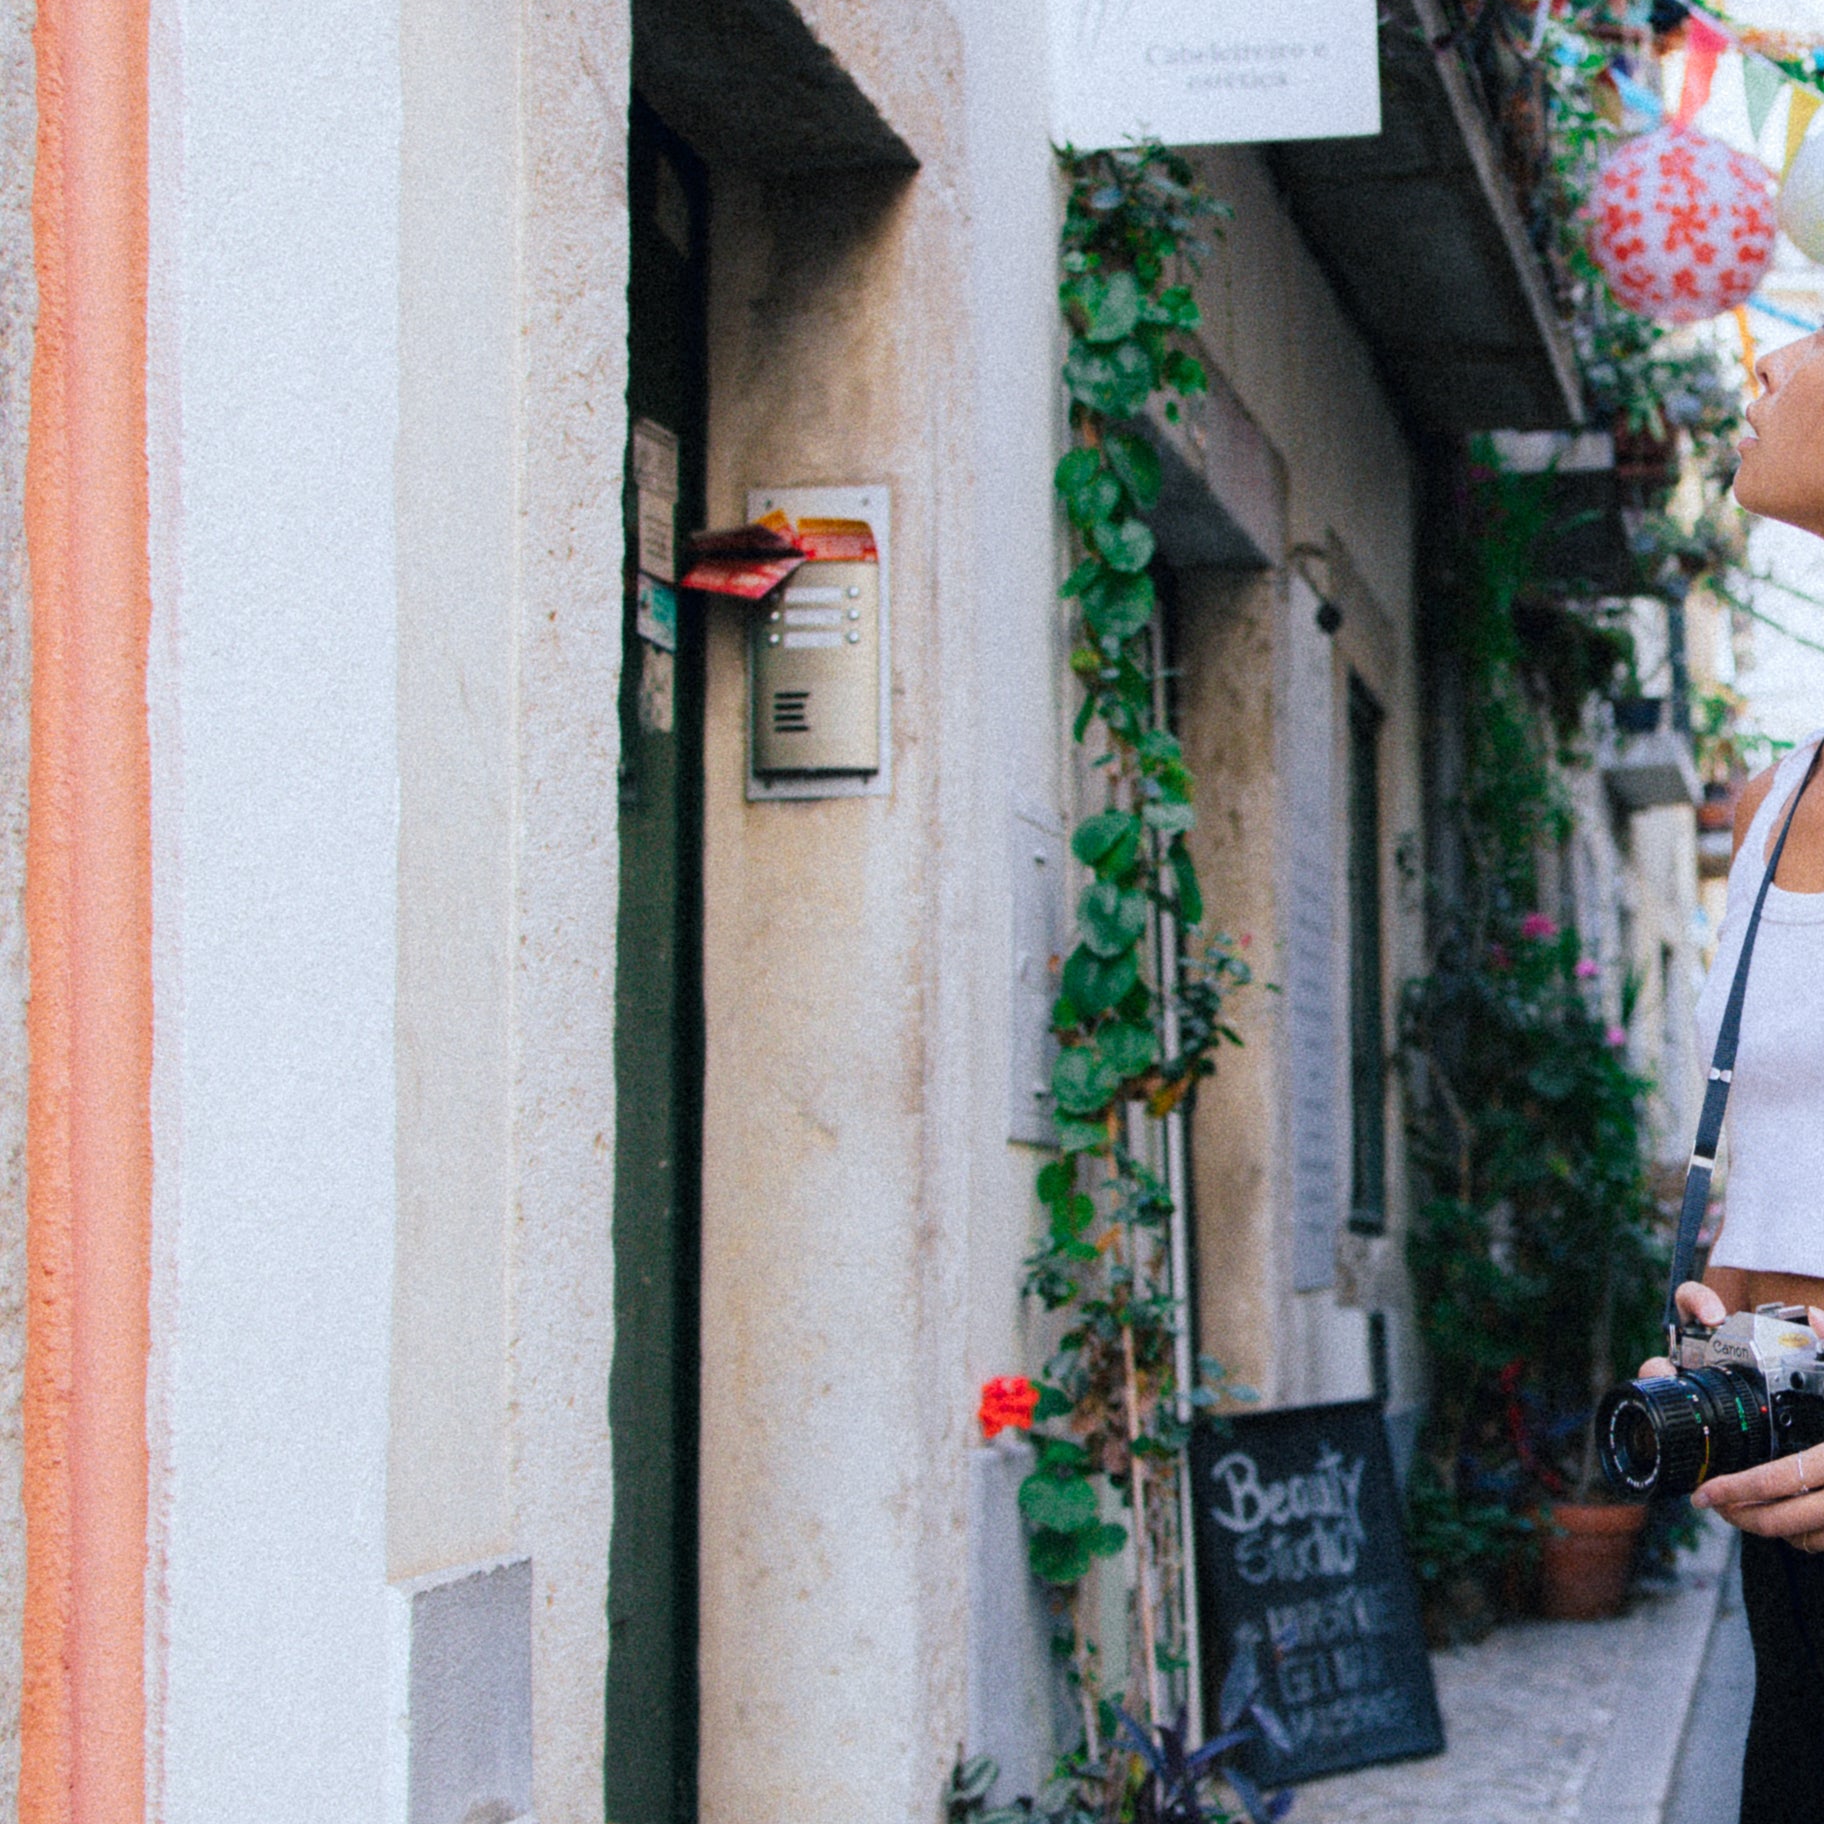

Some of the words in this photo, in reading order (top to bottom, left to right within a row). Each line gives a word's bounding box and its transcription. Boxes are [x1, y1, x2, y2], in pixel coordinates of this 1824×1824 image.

[1713, 1339, 1750, 1359] Canon
[1211, 1440, 1368, 1544] Beauty
[1234, 1520, 1358, 1584] Studio
